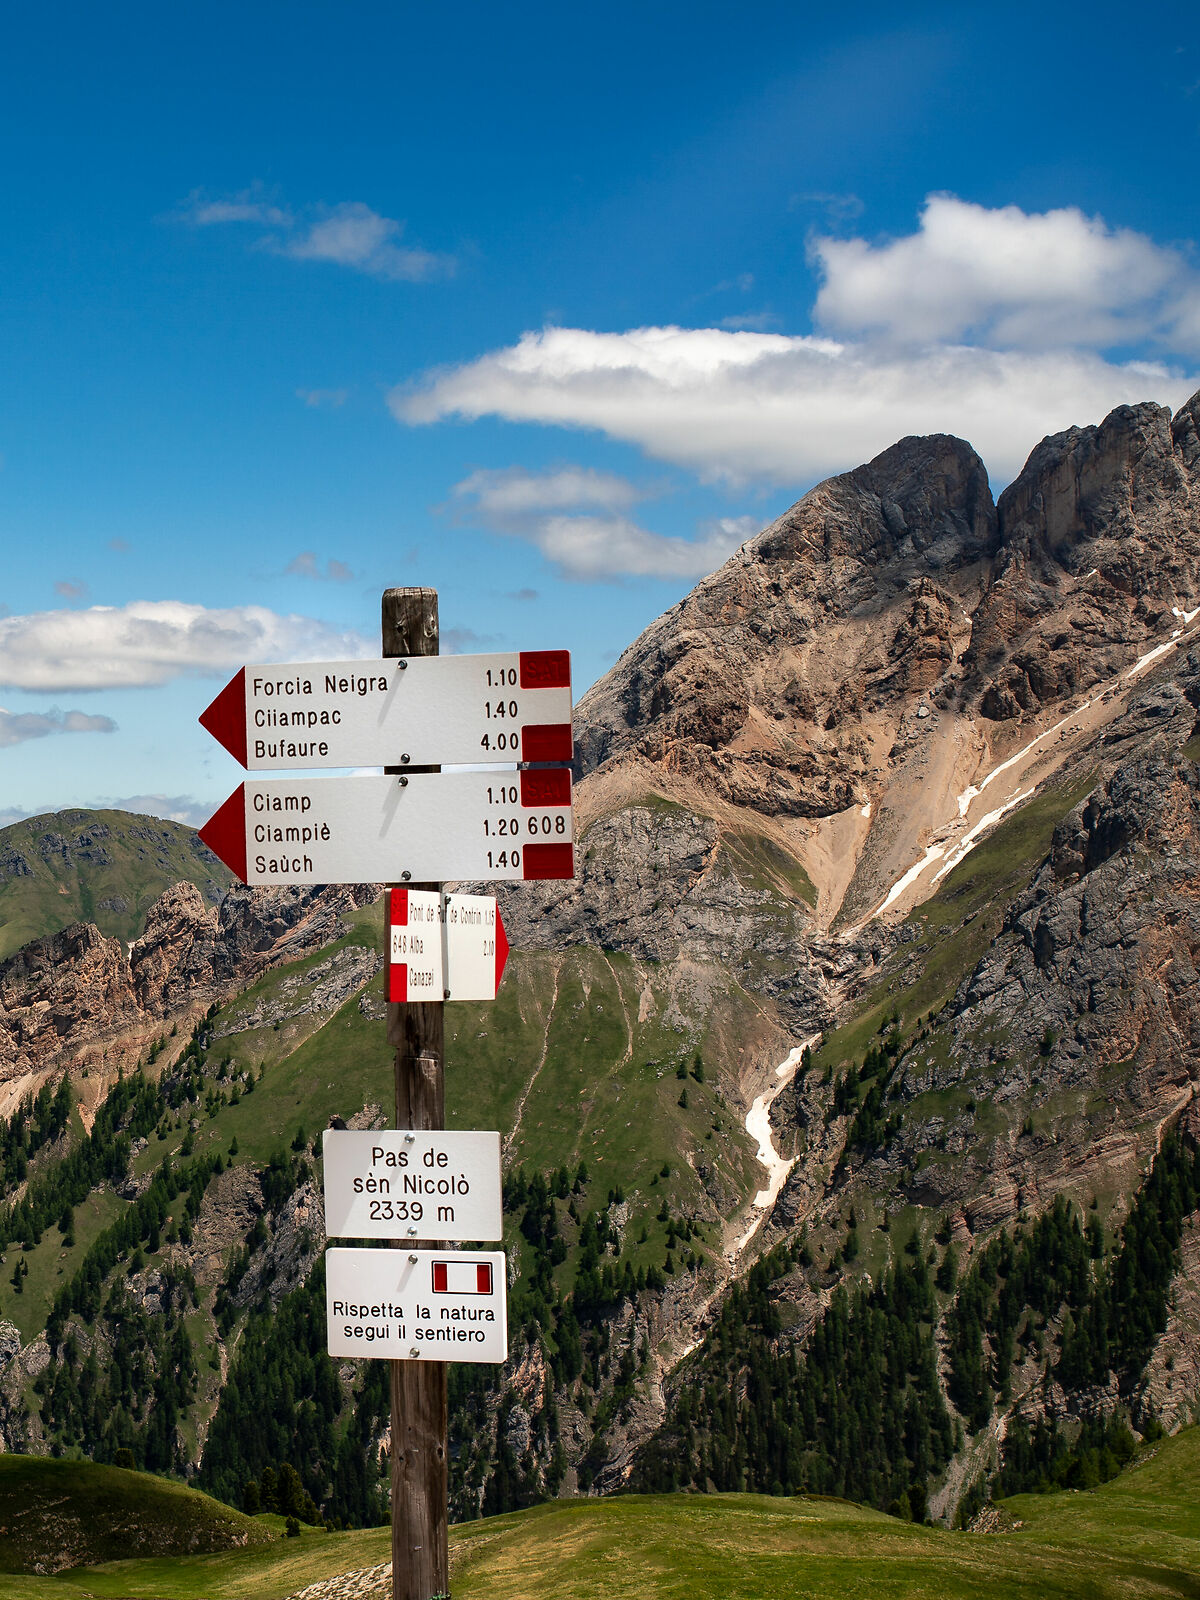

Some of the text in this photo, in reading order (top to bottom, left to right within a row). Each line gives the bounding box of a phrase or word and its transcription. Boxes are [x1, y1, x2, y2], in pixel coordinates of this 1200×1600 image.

[254, 669, 517, 696] Forcia Neigra 1.10
[255, 701, 518, 728] Ciiampac 1.40
[255, 733, 518, 758] Bufaure 4.00
[254, 787, 518, 813] Ciamp 1.10
[255, 819, 519, 844] Ciampiè 1.20
[528, 816, 565, 835] 608
[256, 851, 520, 873] Saùch 1.40
[410, 902, 423, 921] Pont
[426, 903, 434, 921] de
[450, 905, 458, 924] de
[460, 906, 482, 925] Contrin
[394, 935, 494, 956] 648 Alba 2.10
[409, 967, 434, 986] Canazei
[372, 1147, 448, 1167] Pas de
[353, 1172, 469, 1195] sèn Nicolò
[370, 1201, 454, 1222] 2339 m
[334, 1301, 495, 1321] Rispetta la natura
[344, 1325, 485, 1342] segui il sentiero
